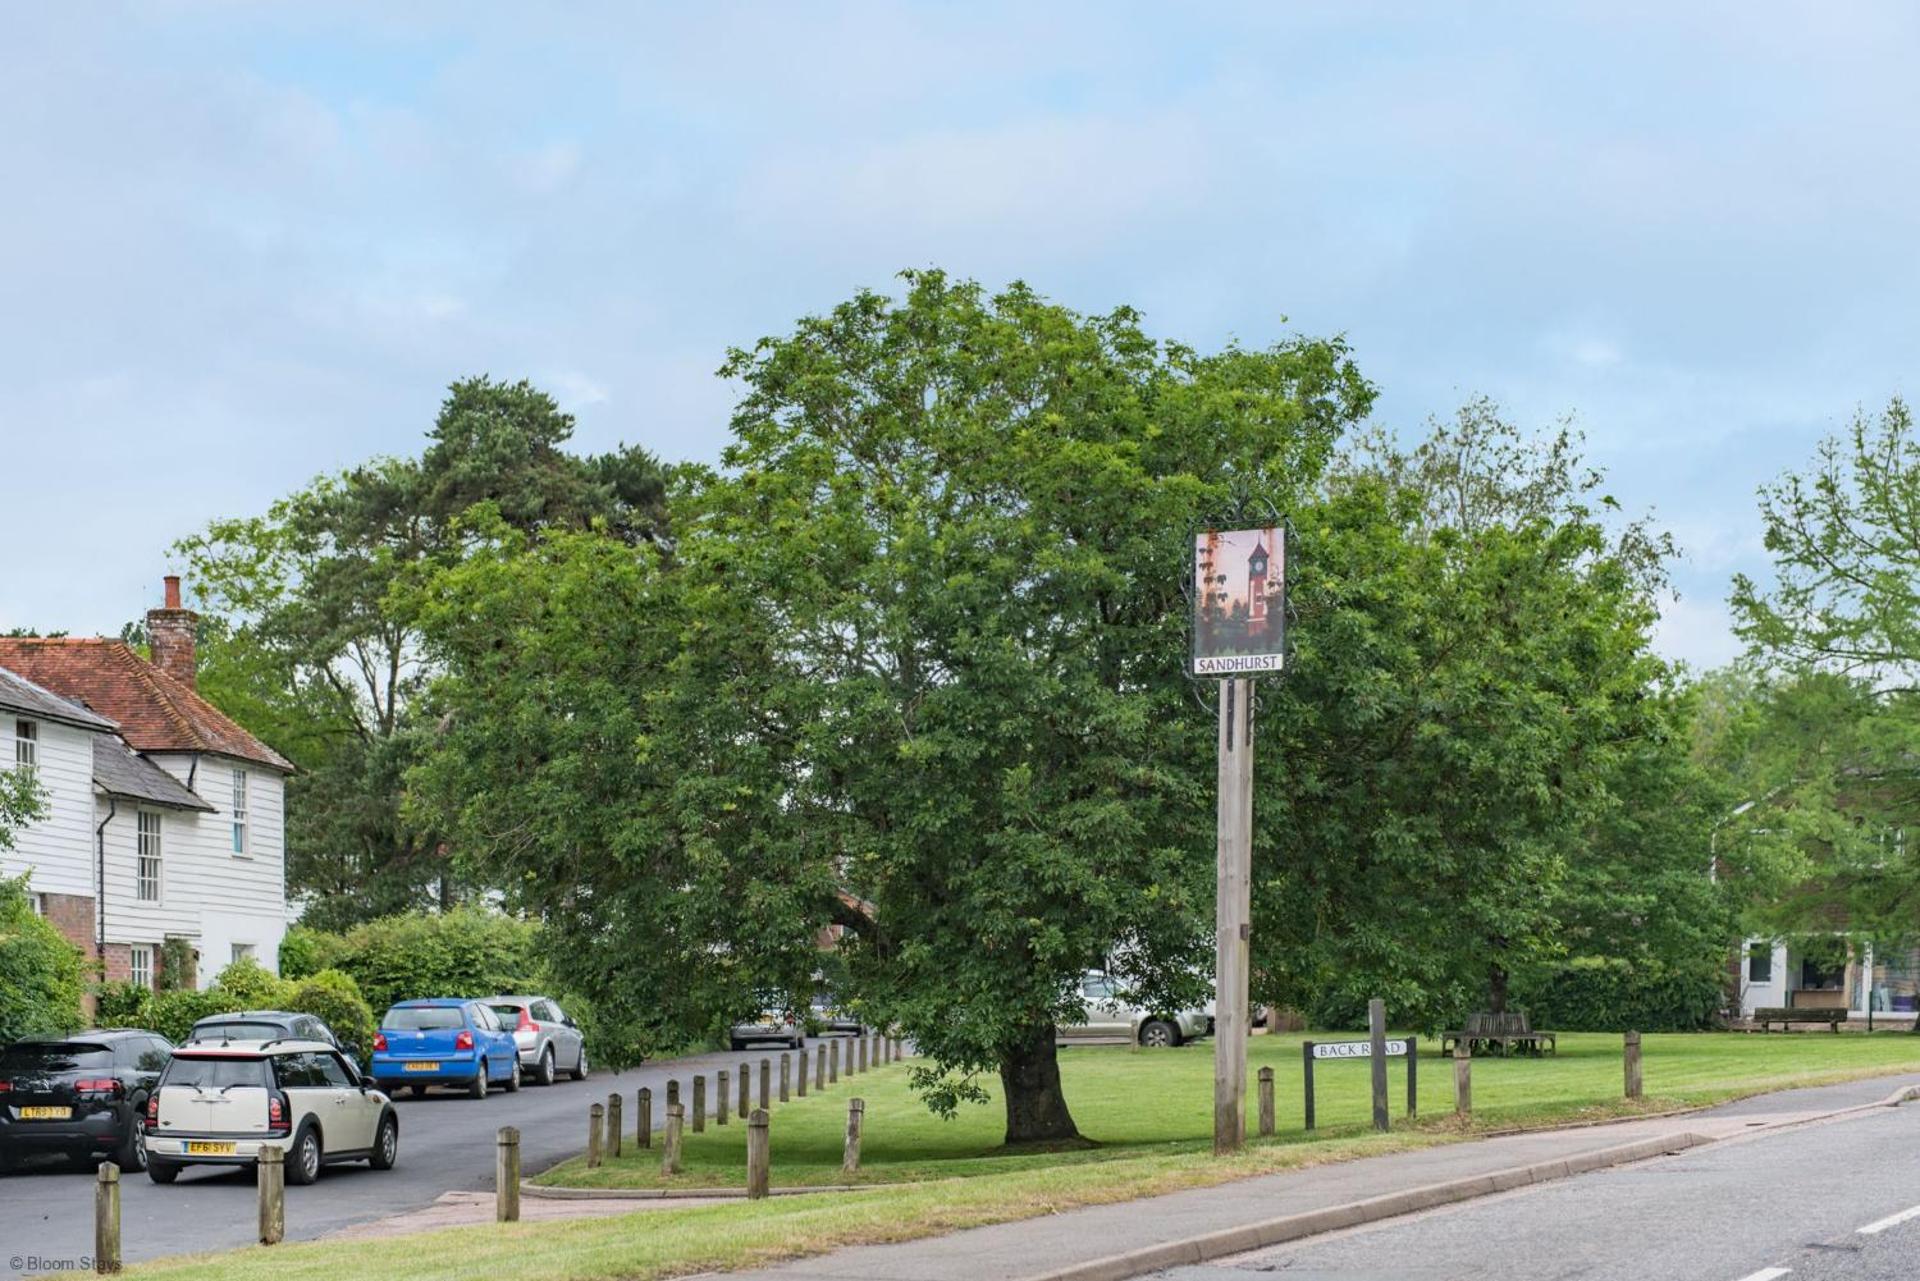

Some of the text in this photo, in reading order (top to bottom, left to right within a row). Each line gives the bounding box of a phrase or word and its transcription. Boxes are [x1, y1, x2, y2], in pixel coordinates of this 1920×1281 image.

[1199, 656, 1277, 672] SANDHURST
[1319, 1043, 1400, 1057] BACK RD
